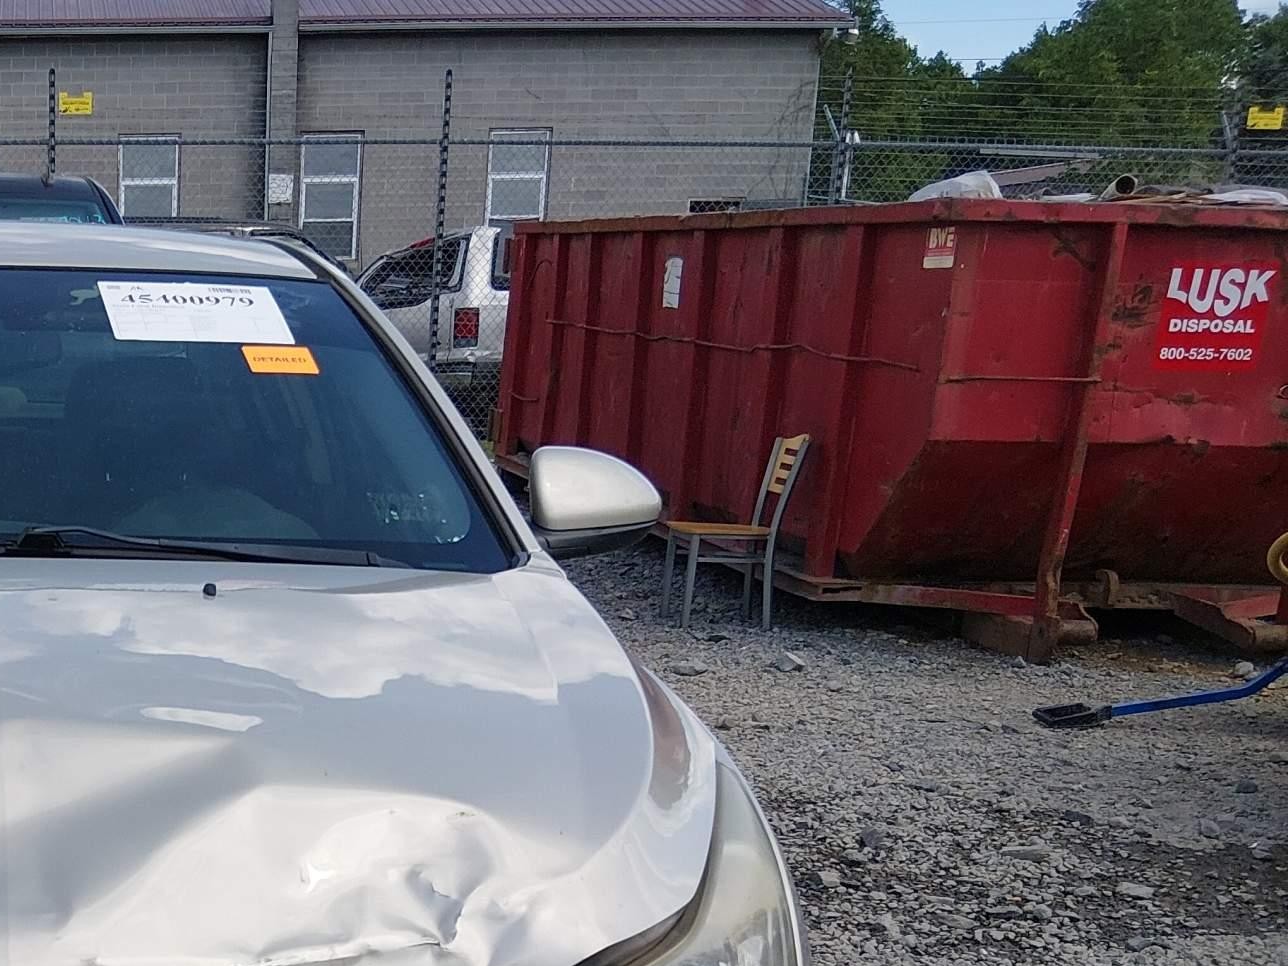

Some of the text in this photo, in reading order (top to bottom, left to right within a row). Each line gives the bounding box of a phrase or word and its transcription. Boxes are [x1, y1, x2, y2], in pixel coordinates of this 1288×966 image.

[1166, 267, 1278, 317] LUSK
[120, 293, 255, 308] 45400979
[1168, 318, 1256, 334] DISPOSAL
[252, 356, 308, 364] DETAILED
[1158, 347, 1254, 361] 800-525-7602
